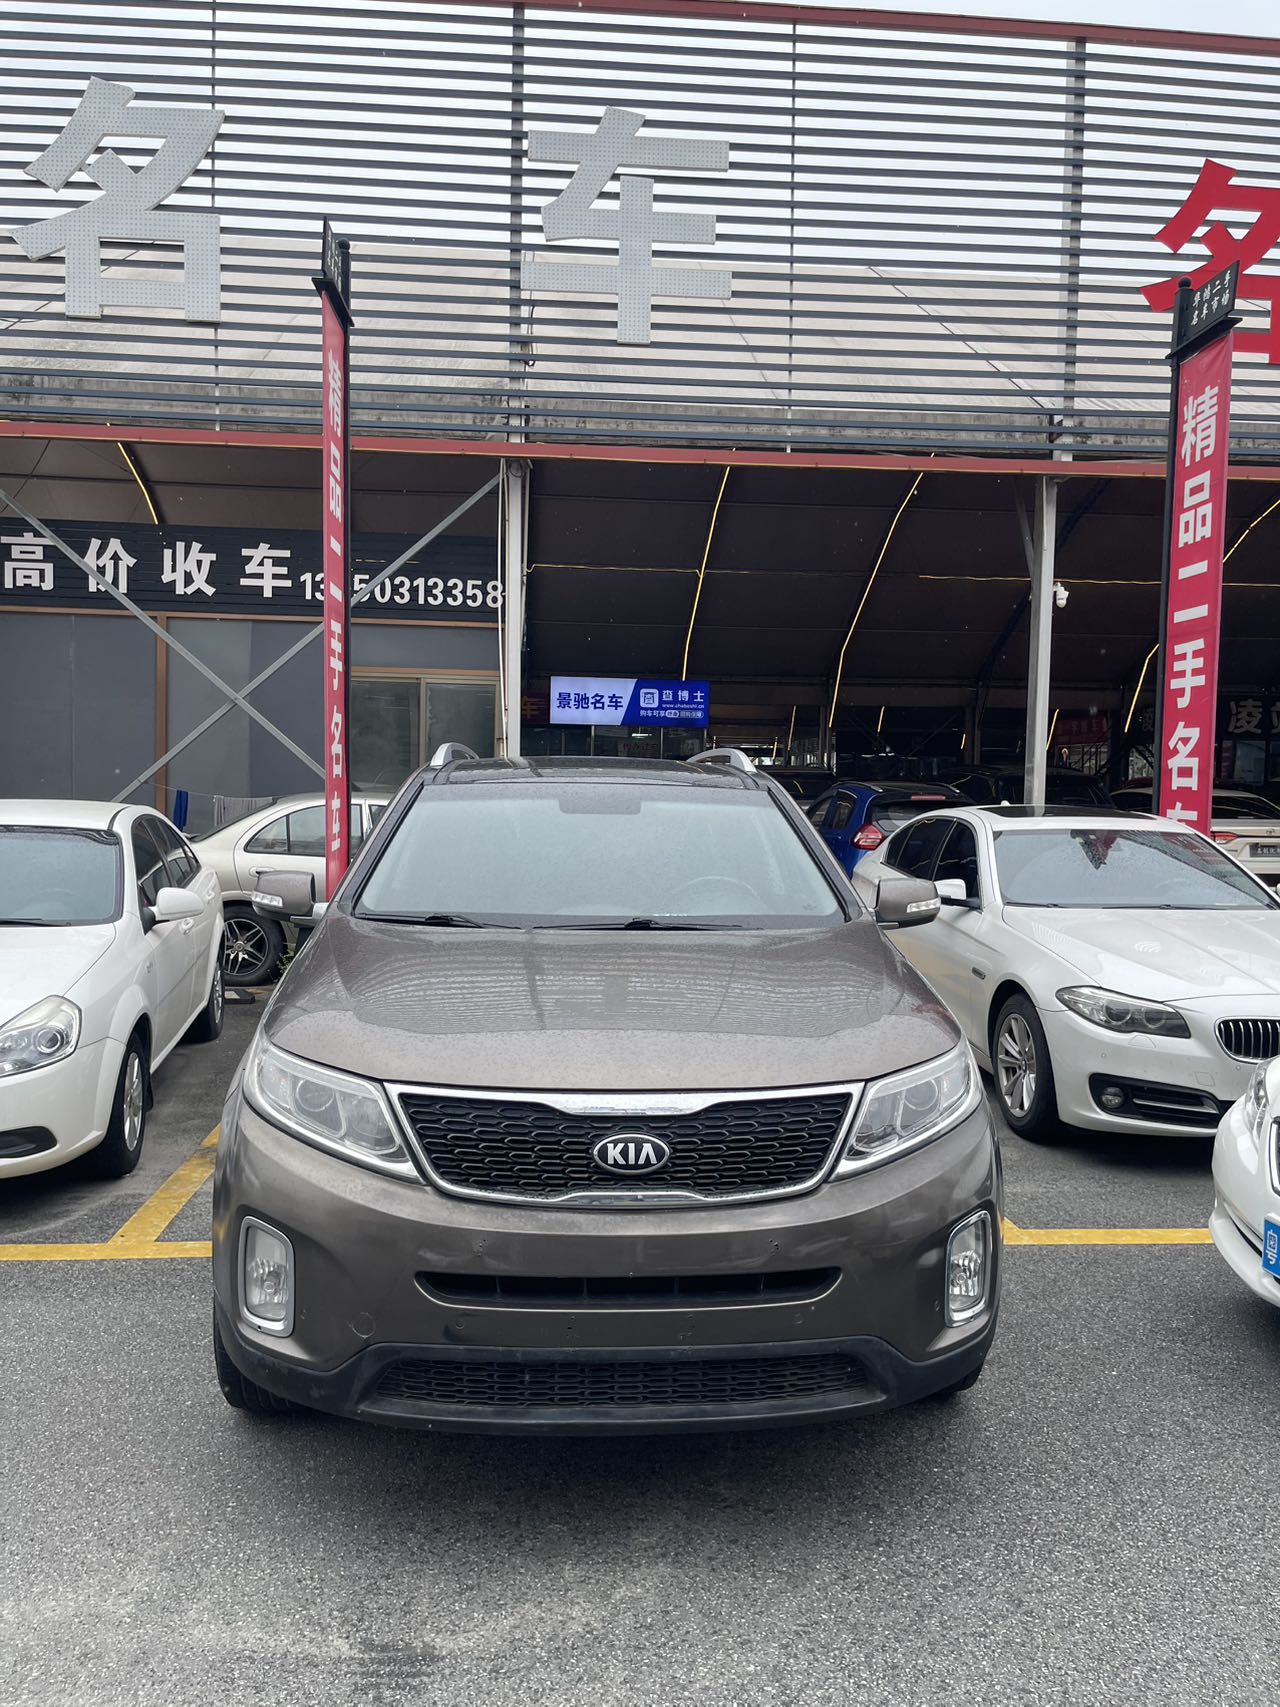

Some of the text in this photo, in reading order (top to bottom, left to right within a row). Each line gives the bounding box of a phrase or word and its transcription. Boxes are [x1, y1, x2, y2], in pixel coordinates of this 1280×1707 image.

[1, 532, 503, 608] 高价收车 1350313358
[556, 692, 624, 711] 景驰名车
[662, 689, 705, 702] 查博士
[606, 1142, 658, 1165] KIA
